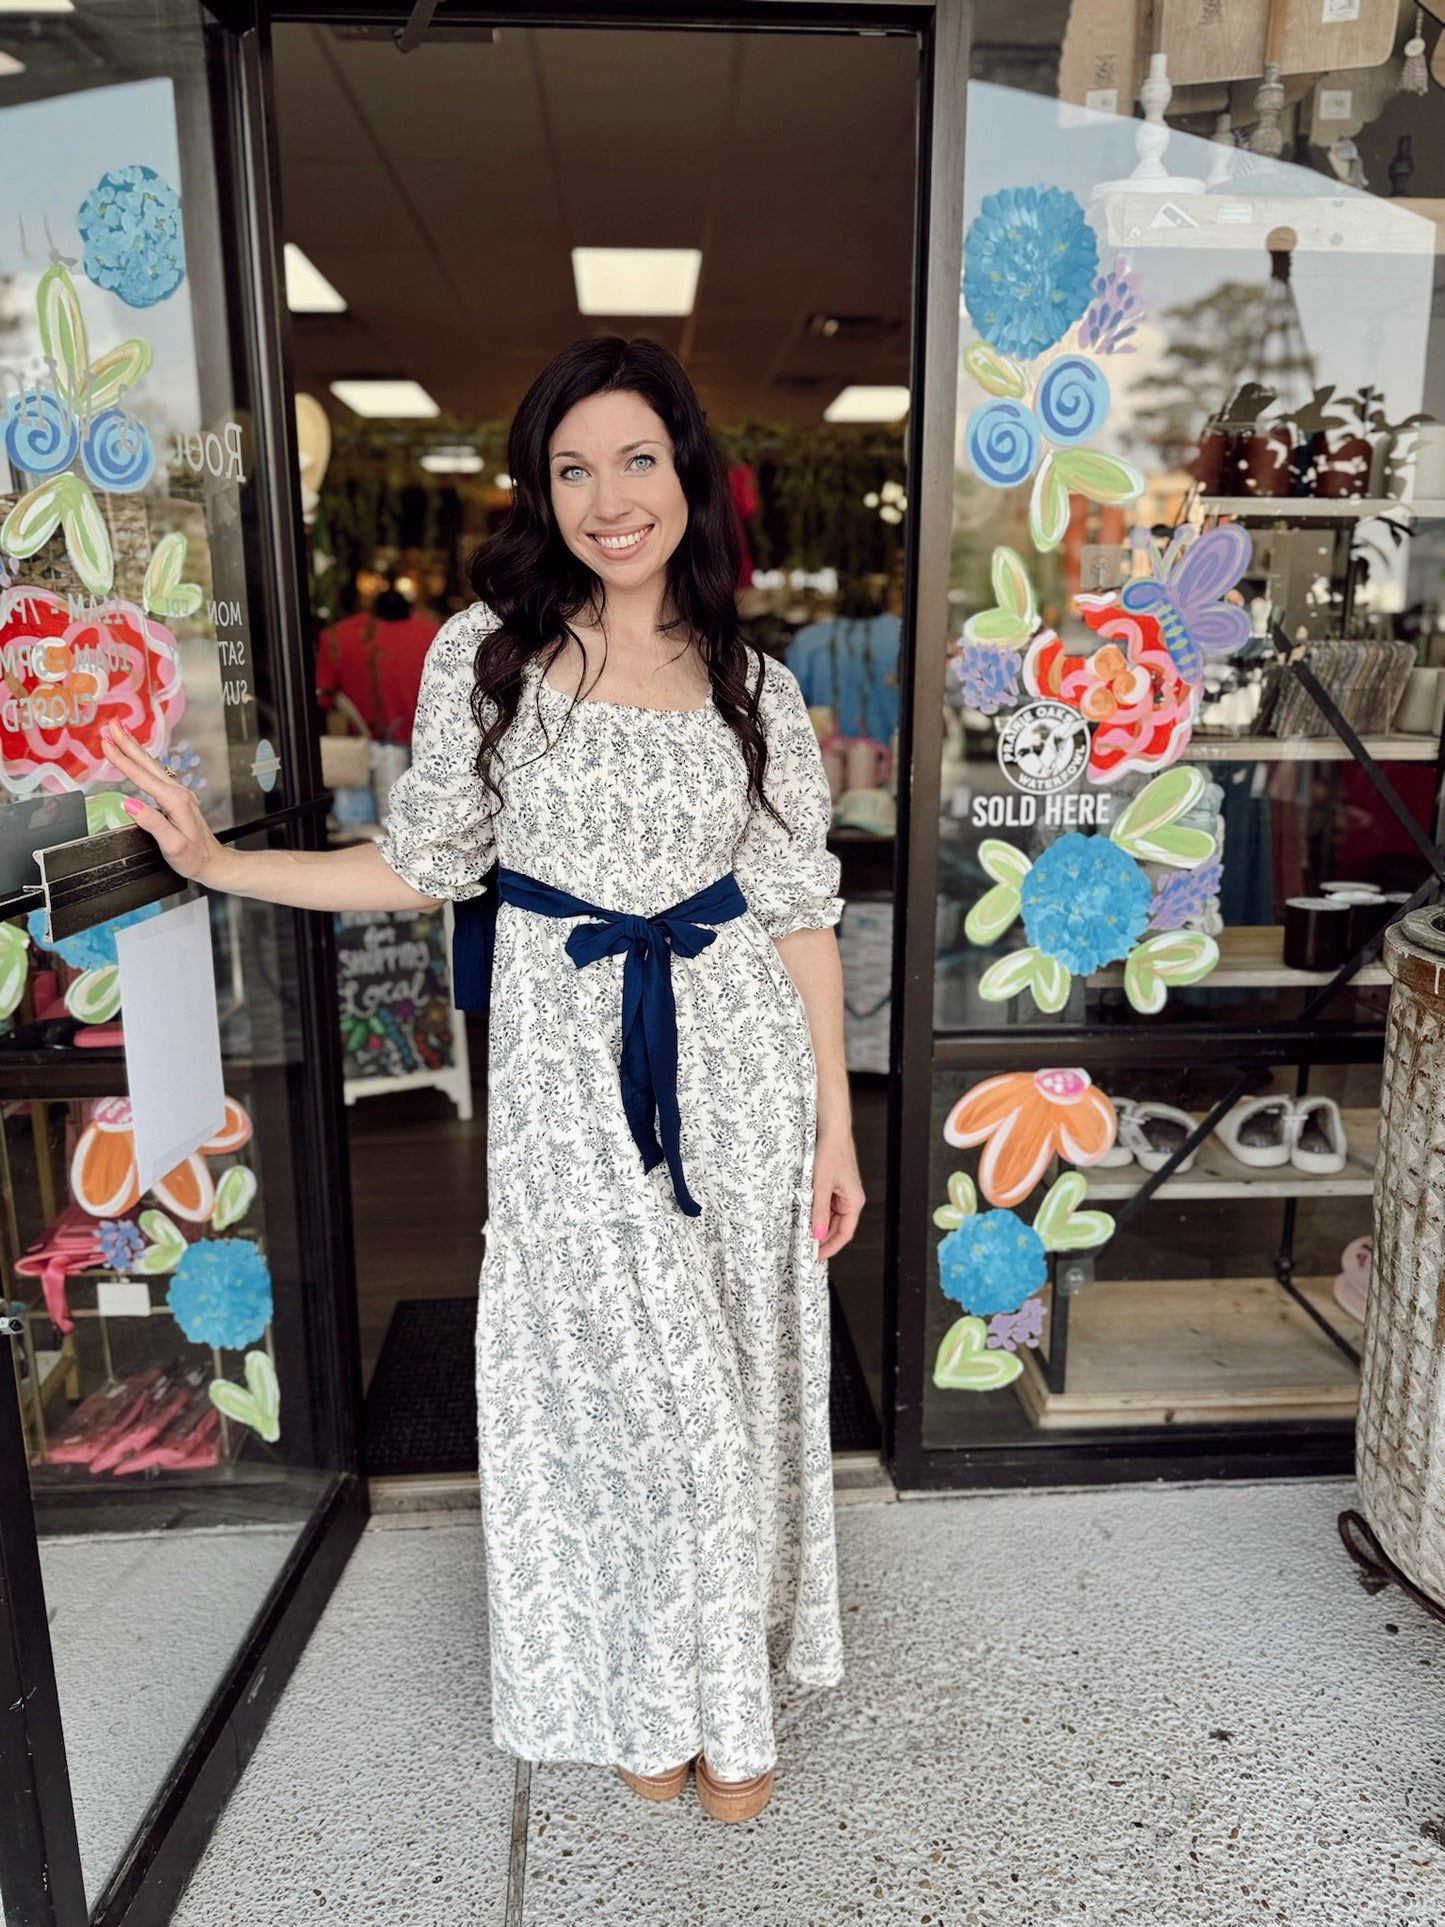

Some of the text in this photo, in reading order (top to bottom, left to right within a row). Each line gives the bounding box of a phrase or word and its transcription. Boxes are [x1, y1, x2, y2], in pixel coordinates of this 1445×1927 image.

[1018, 744, 1087, 790] WATERFOWL
[971, 793, 1112, 828] SOLD HERE
